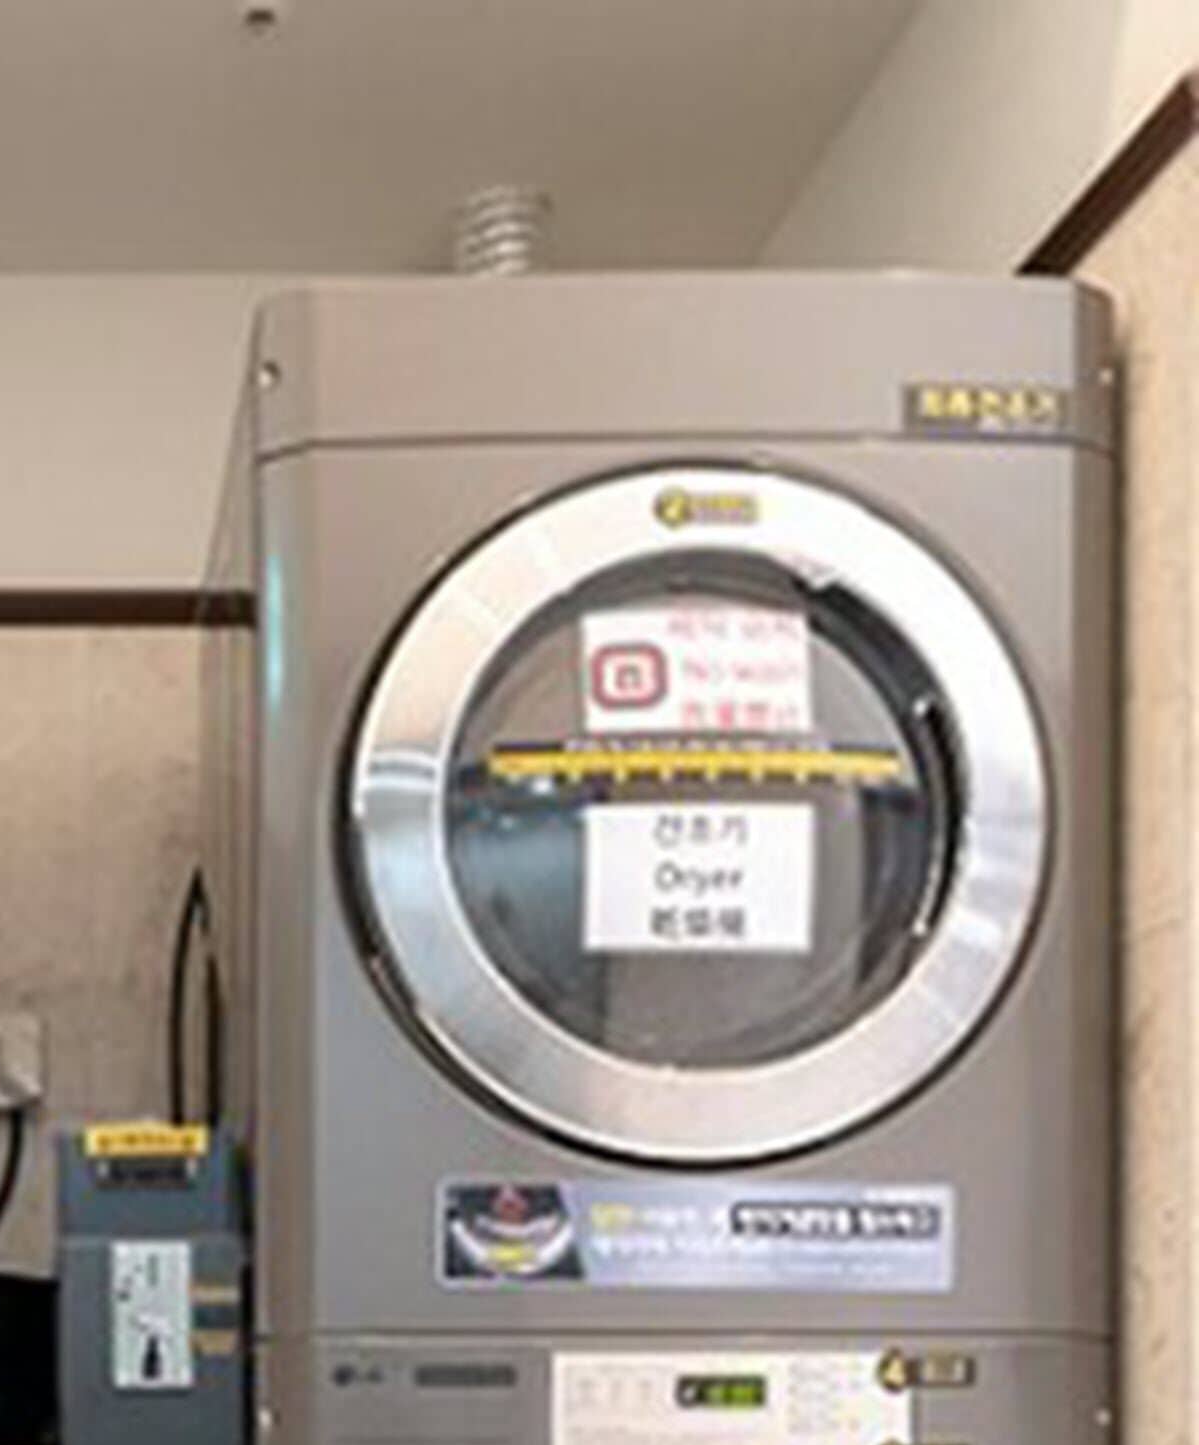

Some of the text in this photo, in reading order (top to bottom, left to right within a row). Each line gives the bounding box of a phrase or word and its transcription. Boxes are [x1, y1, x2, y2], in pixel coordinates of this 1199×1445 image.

[680, 658, 722, 684] No
[652, 814, 748, 846] 건조기
[654, 863, 744, 894] Dryer
